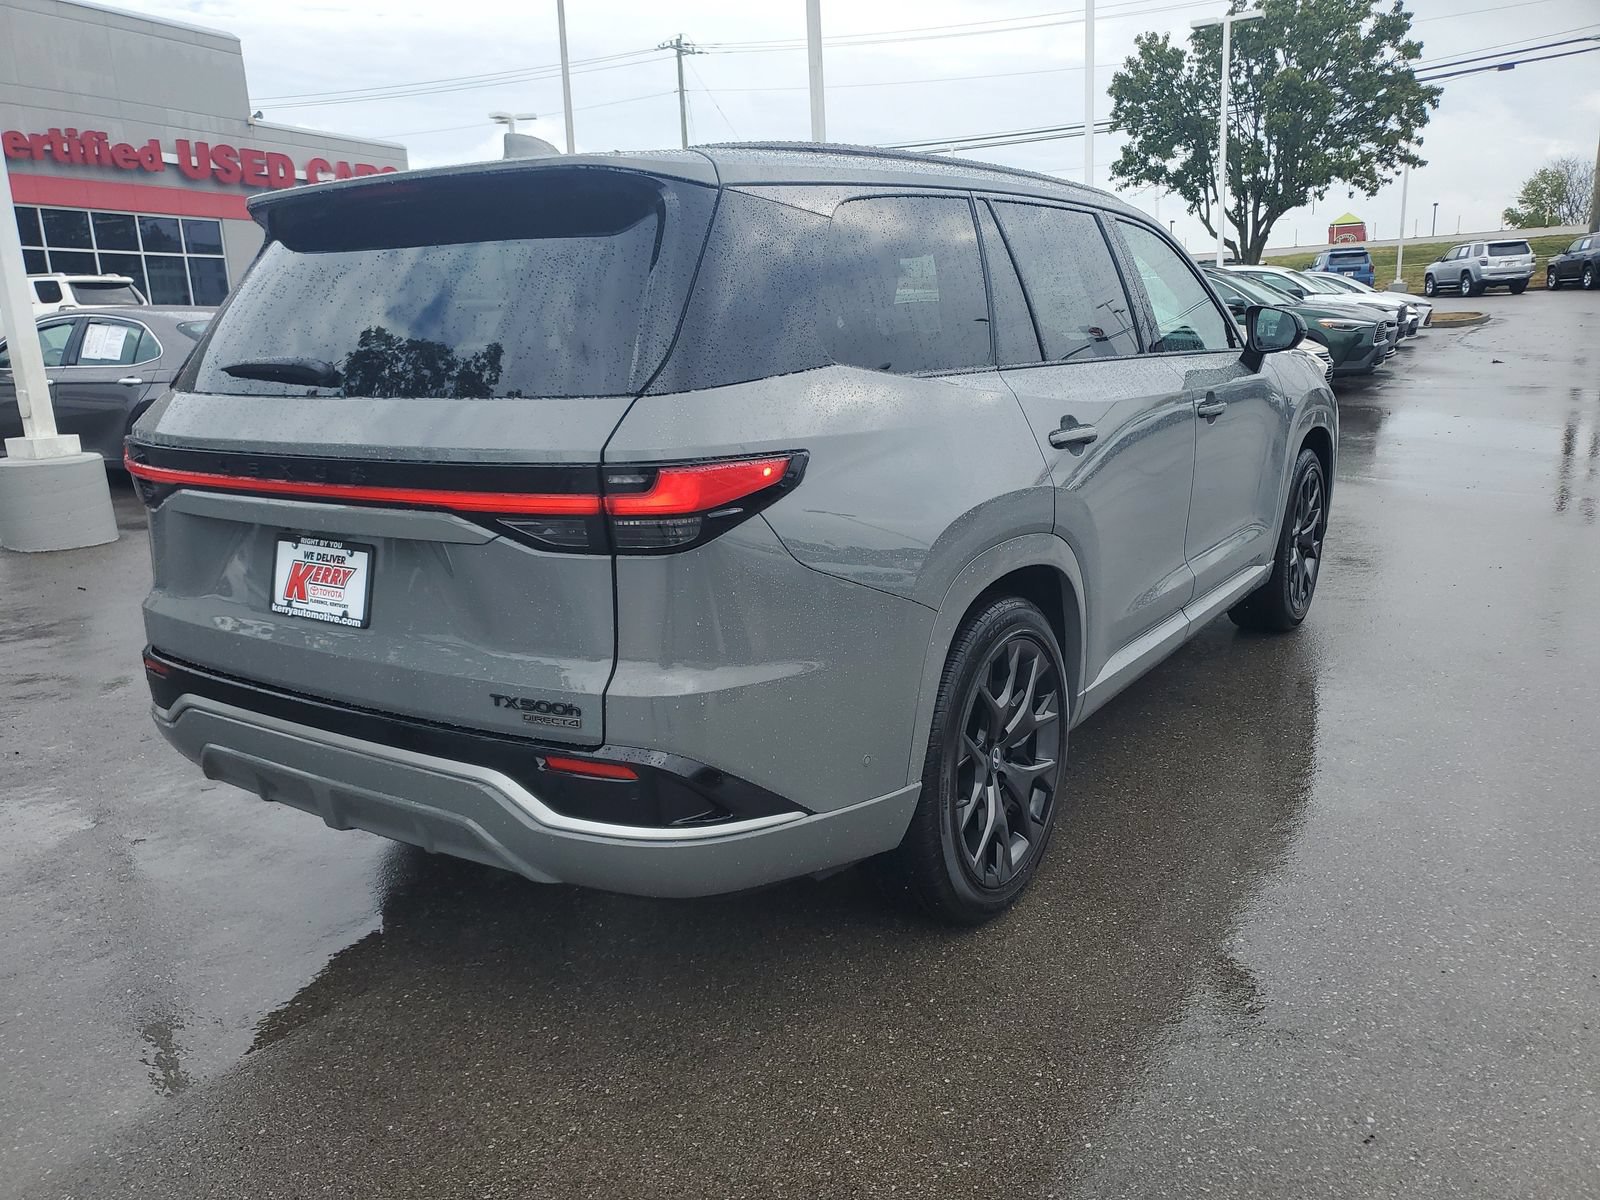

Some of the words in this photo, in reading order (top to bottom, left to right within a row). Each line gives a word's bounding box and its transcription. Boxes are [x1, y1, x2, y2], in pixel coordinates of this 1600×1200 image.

[175, 138, 295, 188] USED
[301, 538, 319, 546] RIGHT
[320, 539, 328, 547] BY
[330, 541, 343, 549] YOU
[304, 551, 315, 560] WE
[316, 553, 346, 564] DELIVER
[285, 561, 354, 602] KERRY
[319, 588, 343, 599] TOYOTA
[272, 603, 361, 627] kerryautomotive.com
